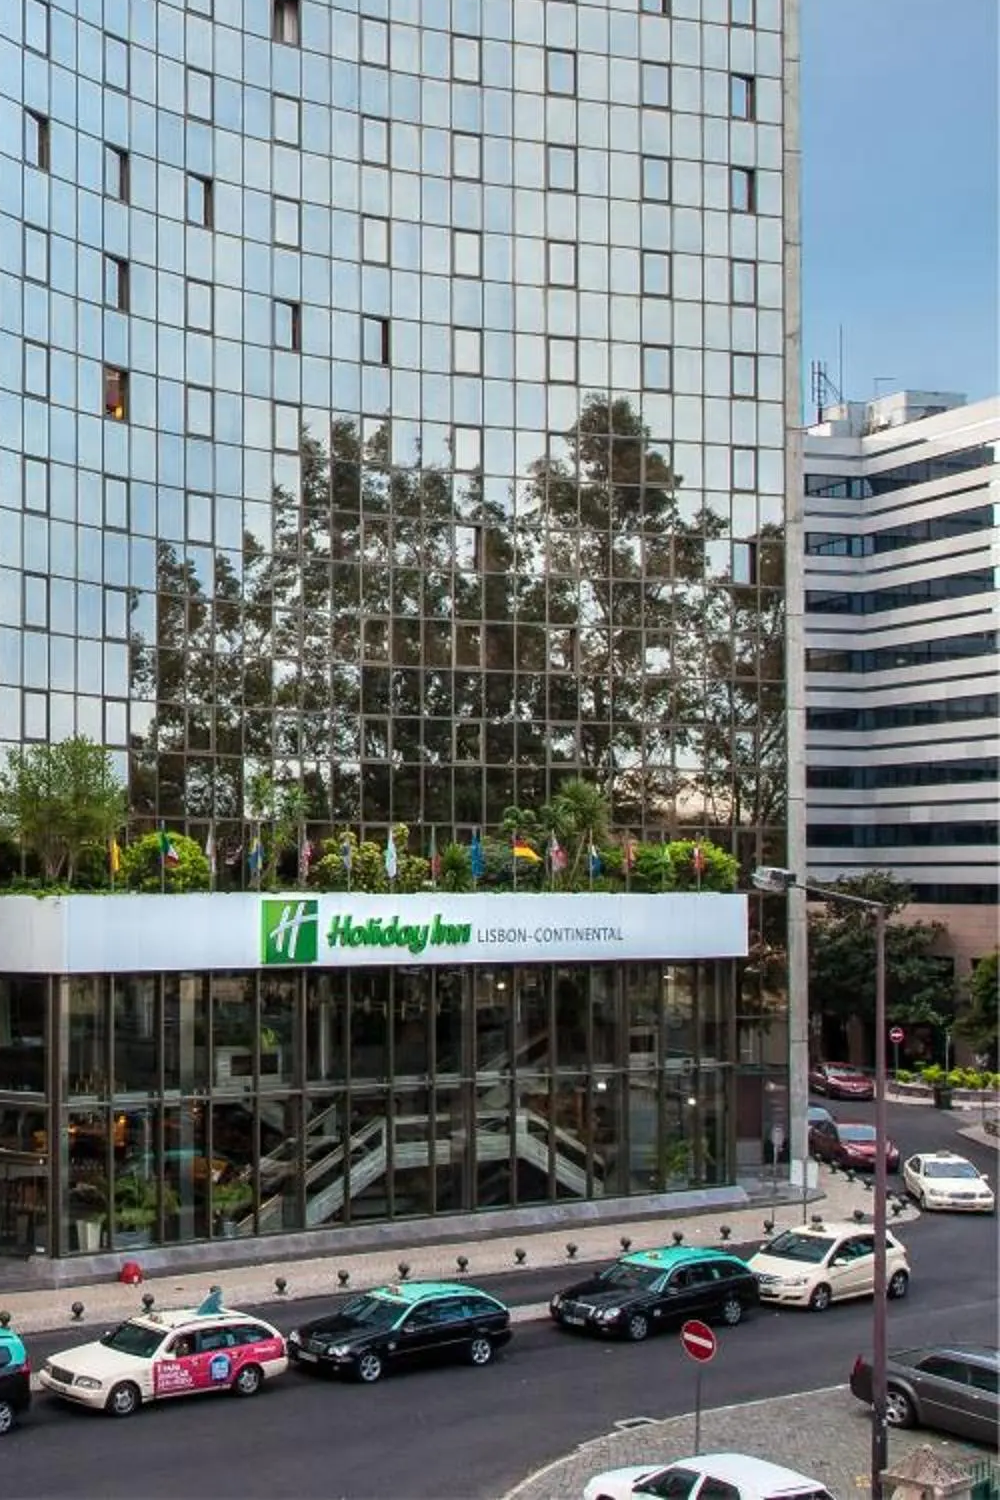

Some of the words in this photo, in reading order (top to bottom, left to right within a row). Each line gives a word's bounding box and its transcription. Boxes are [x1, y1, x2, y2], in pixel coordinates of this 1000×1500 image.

[328, 914, 428, 954] Holiday
[430, 913, 471, 945] Inn
[477, 926, 624, 944] LISBON-CONTINENTAL
